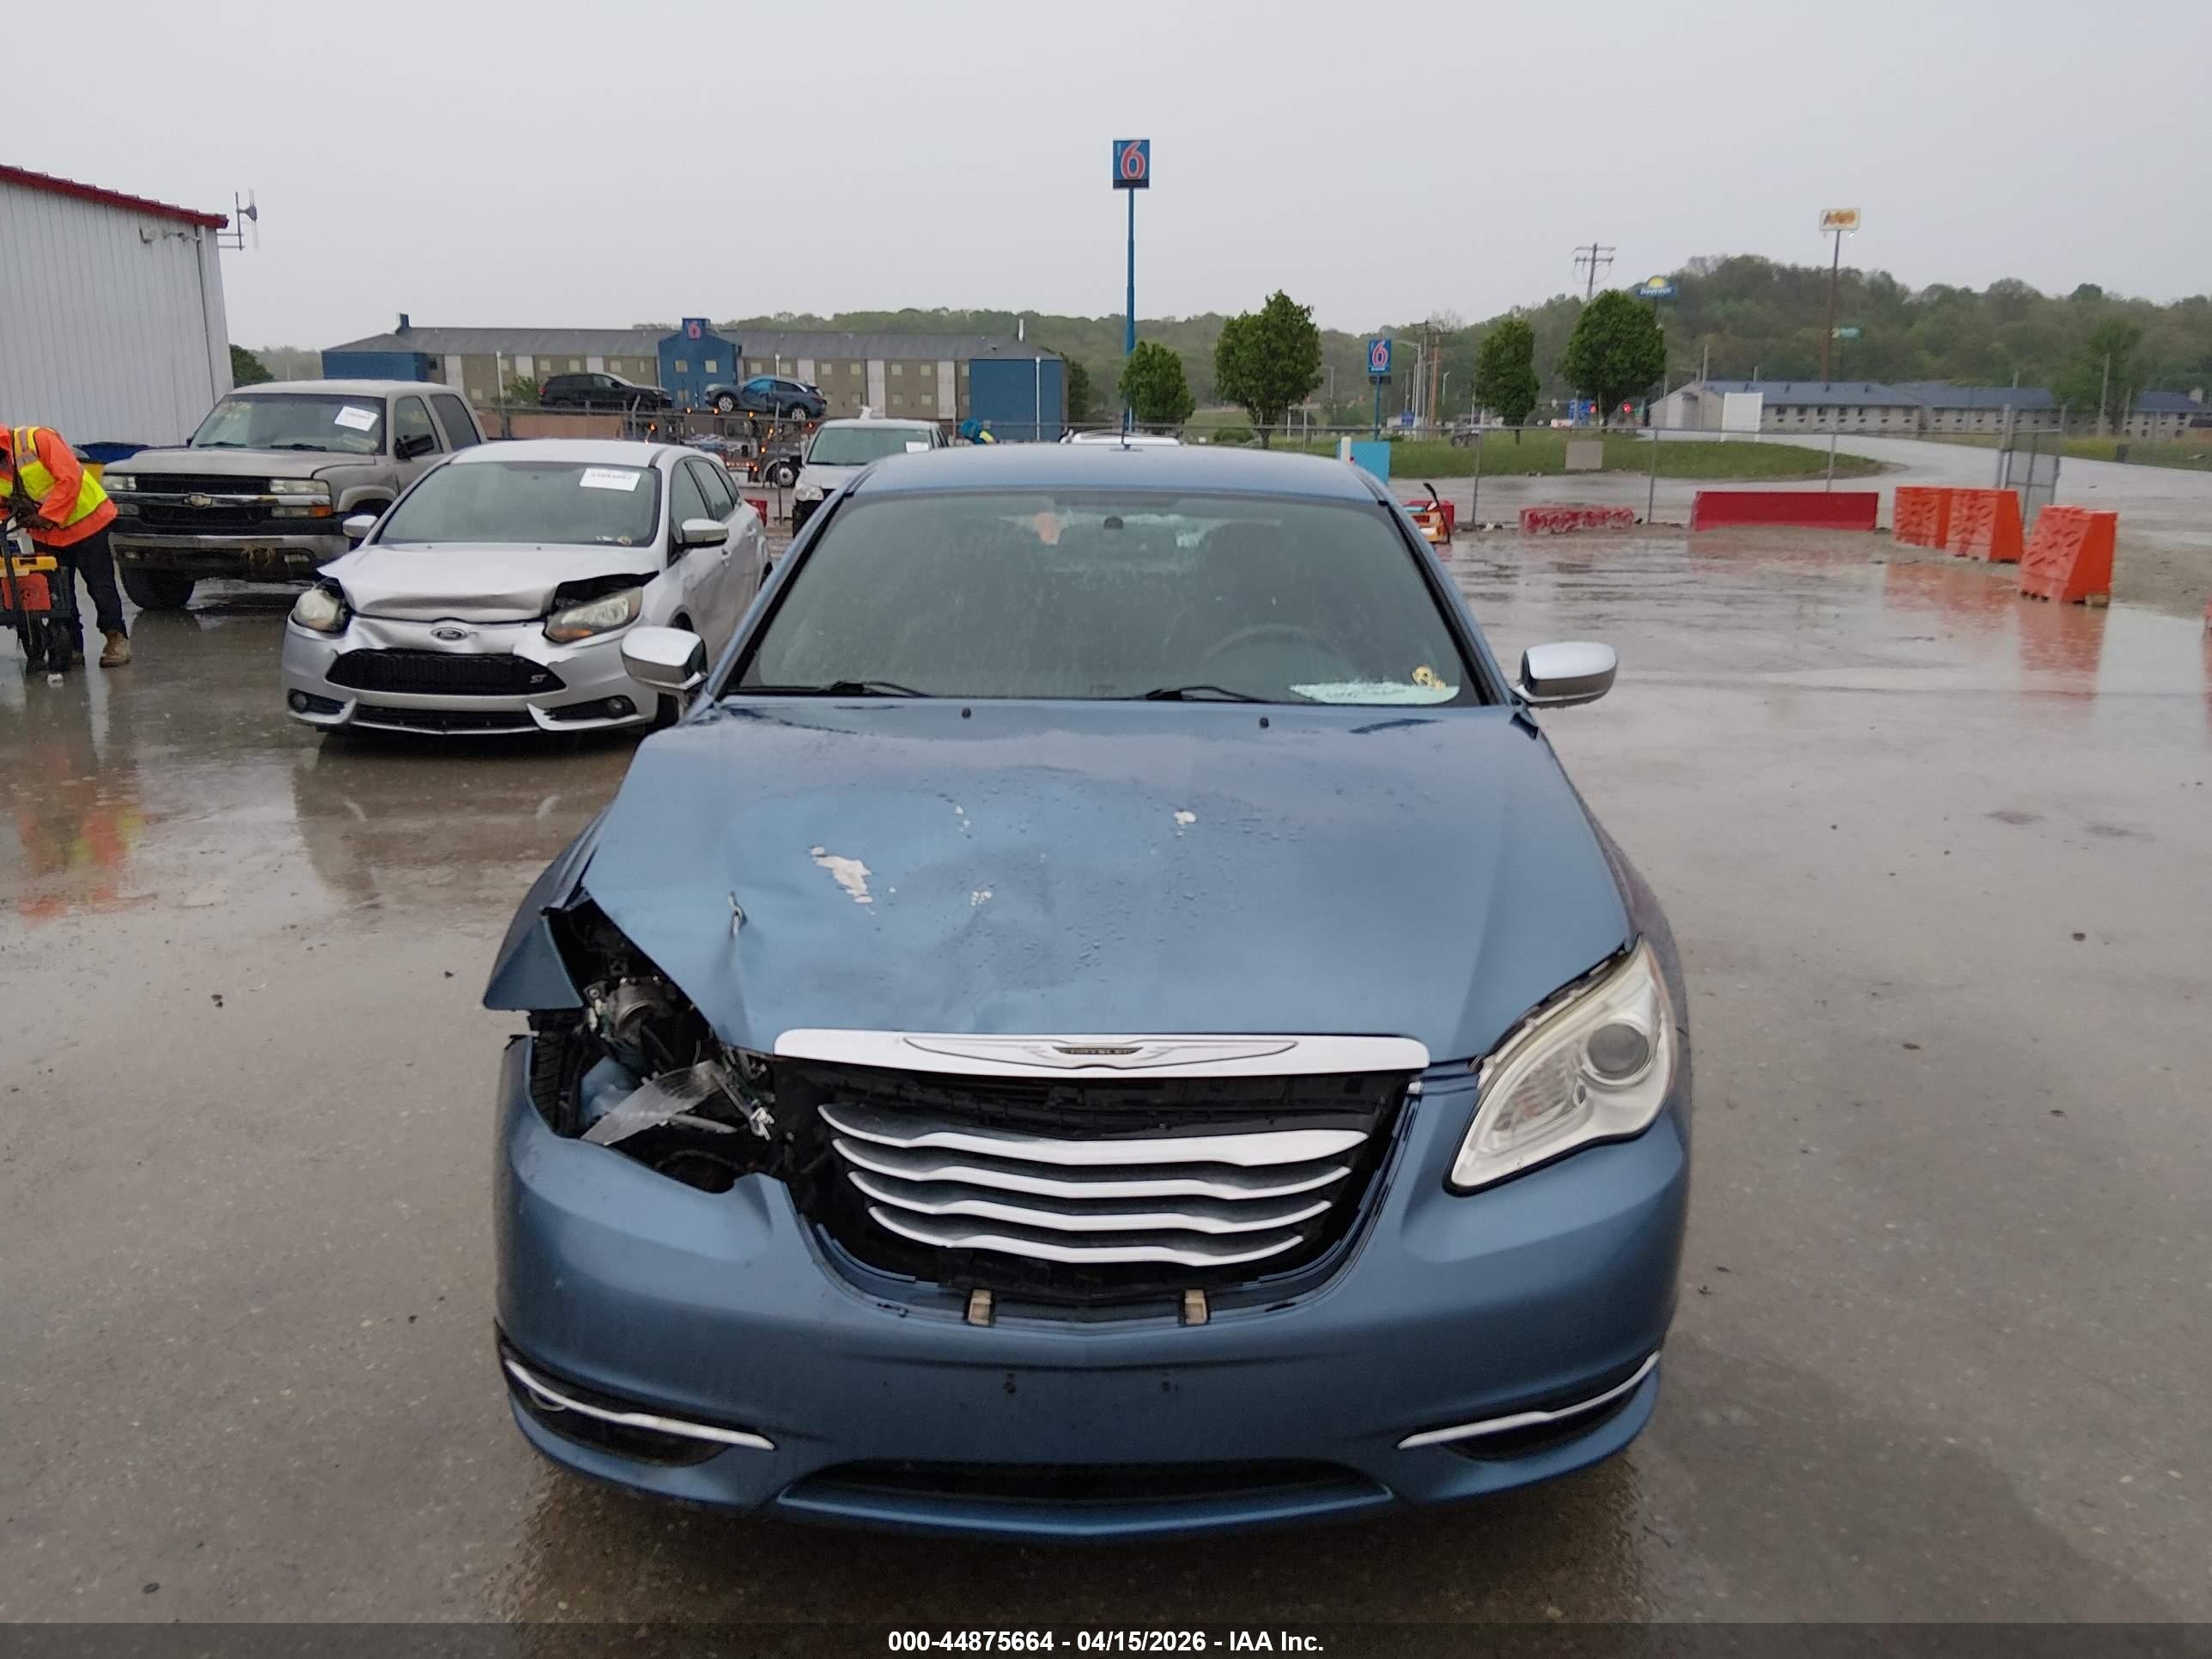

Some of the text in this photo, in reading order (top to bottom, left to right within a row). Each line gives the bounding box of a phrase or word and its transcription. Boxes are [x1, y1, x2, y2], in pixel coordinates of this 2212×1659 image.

[1121, 140, 1146, 179] 6
[688, 321, 702, 340] 6
[1372, 341, 1389, 367] 6
